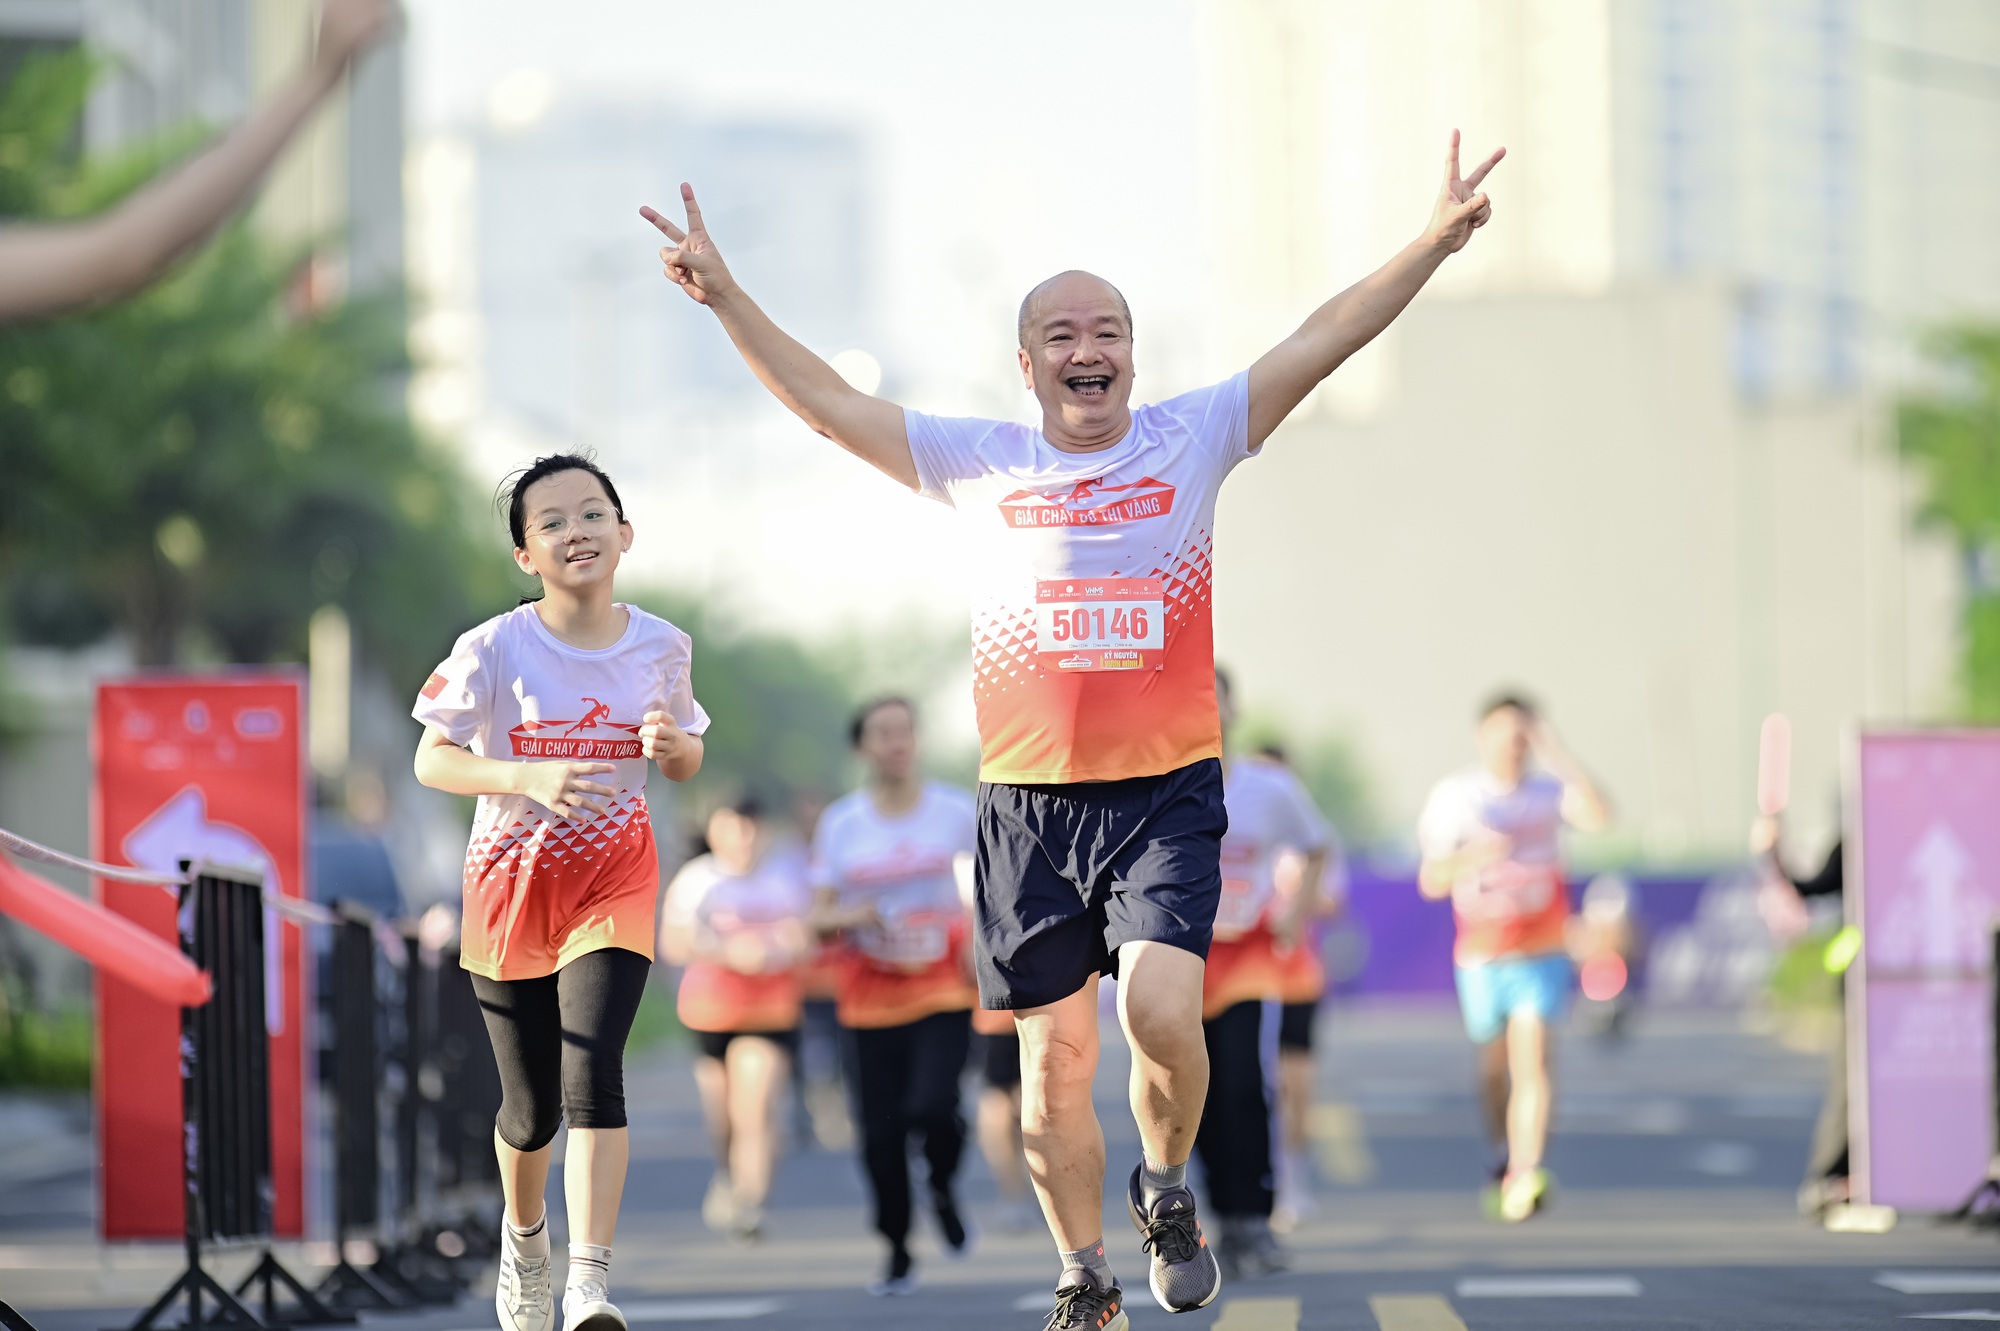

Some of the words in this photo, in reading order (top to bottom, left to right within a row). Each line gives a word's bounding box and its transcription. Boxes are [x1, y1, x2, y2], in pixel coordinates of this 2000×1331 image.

[1014, 507, 1037, 526] GIẢI
[1041, 508, 1074, 527] CHẠY
[1100, 506, 1124, 523] THỊ
[1124, 496, 1161, 519] VÀNG
[1053, 607, 1149, 641] 50146
[520, 738, 542, 755] GIẢI
[545, 741, 576, 758] CHẠY
[577, 741, 594, 757] ĐÔ
[594, 742, 614, 759] THỊ
[614, 742, 639, 757] VÀNG
